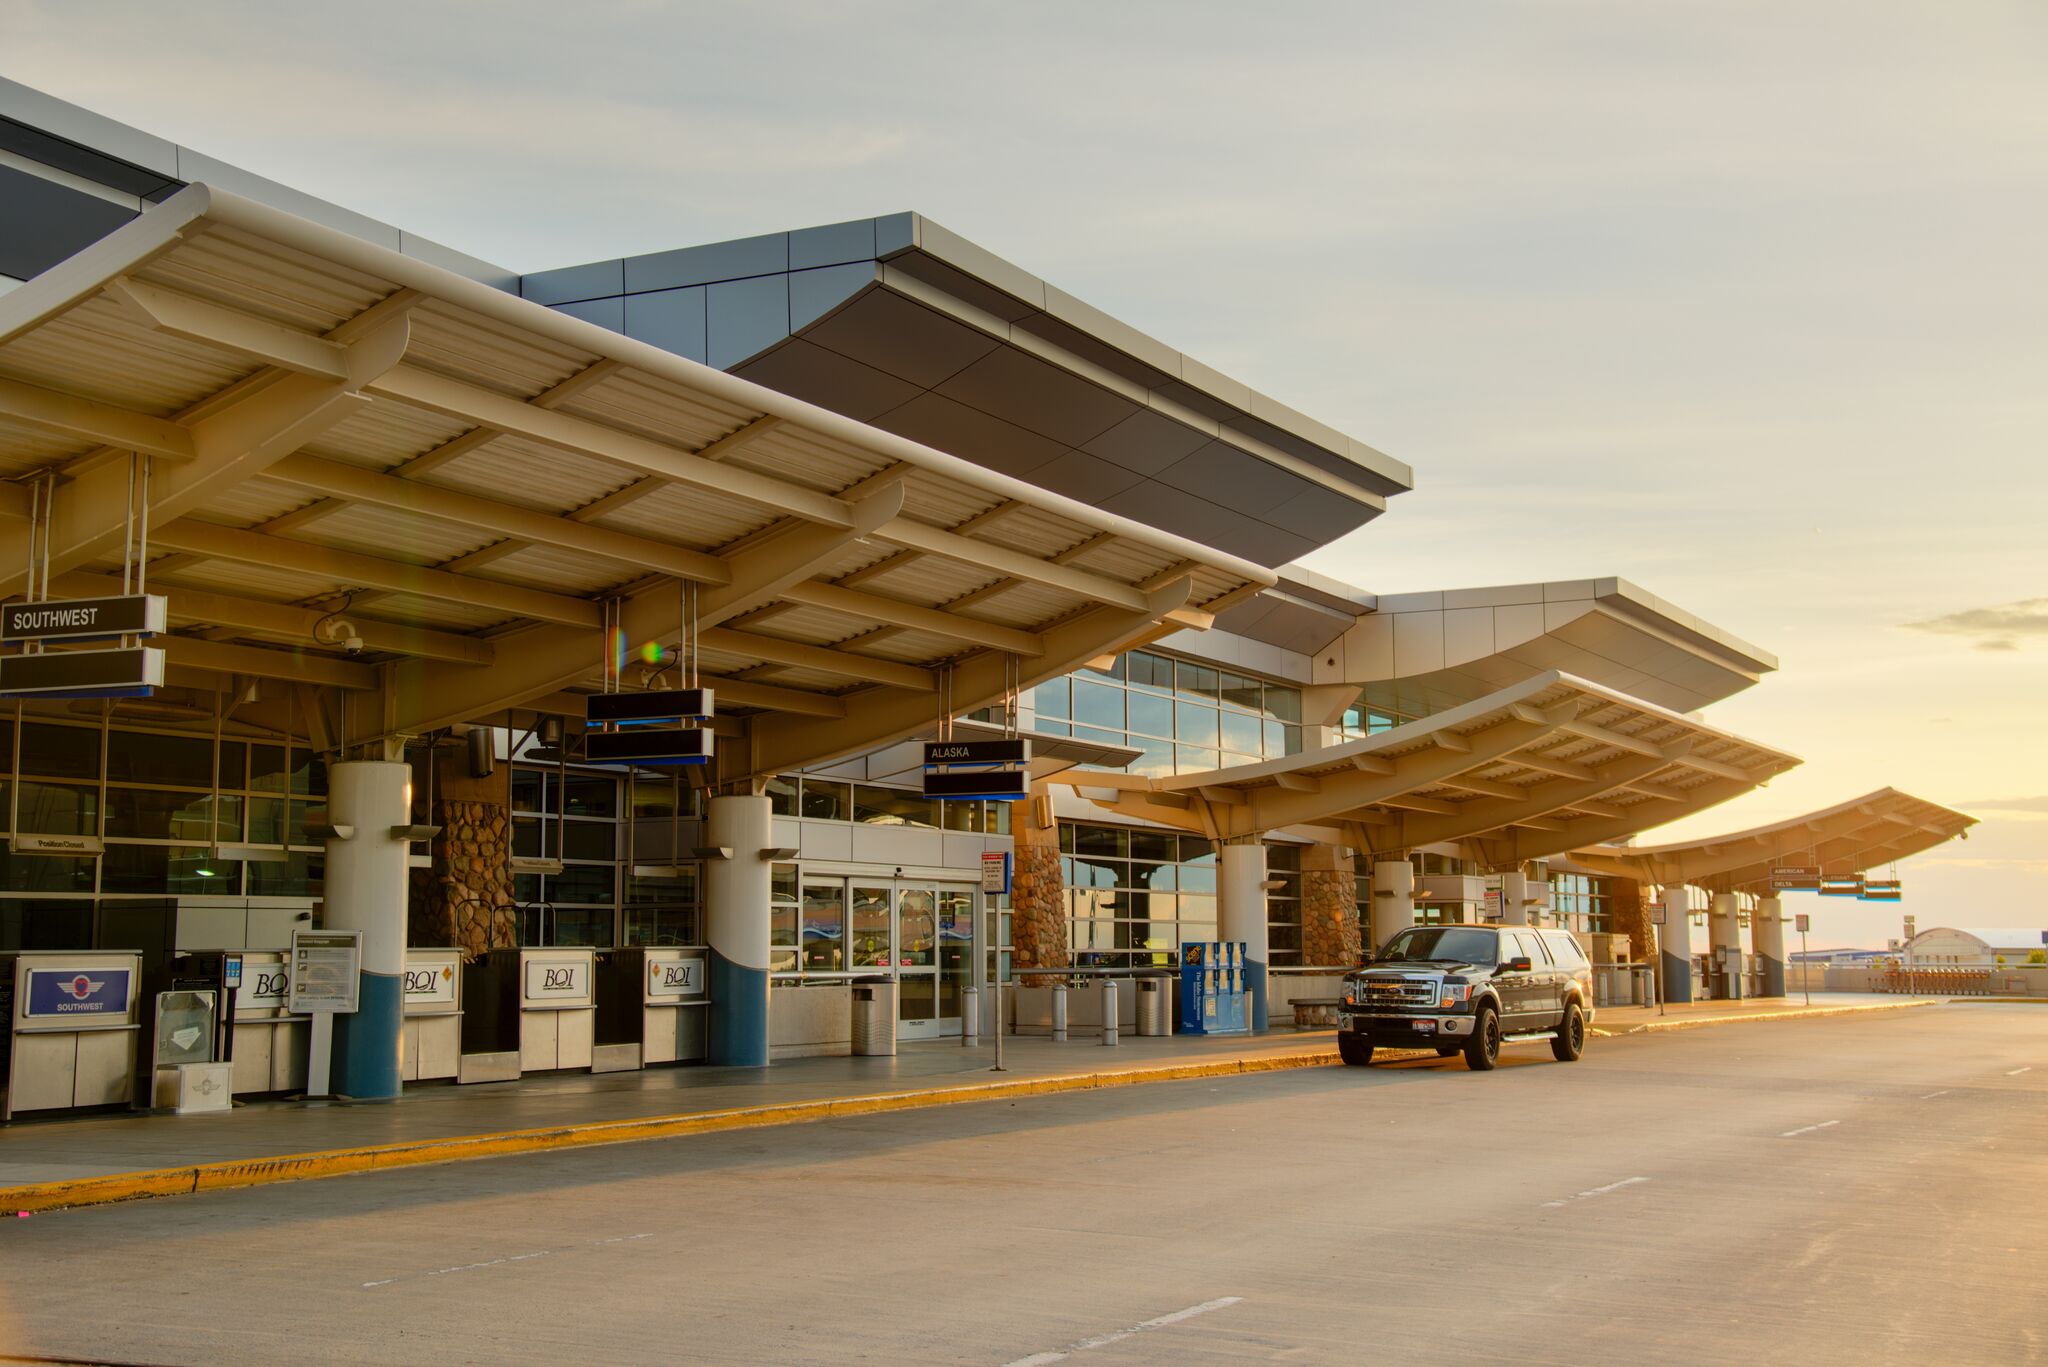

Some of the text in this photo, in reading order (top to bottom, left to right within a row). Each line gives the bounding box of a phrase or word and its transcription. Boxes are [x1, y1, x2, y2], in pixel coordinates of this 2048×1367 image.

[13, 608, 98, 630] SOUTHWEST
[931, 747, 970, 759] ALASKA
[38, 839, 63, 848] Position
[254, 973, 288, 995] BO
[405, 971, 438, 990] BOI
[543, 968, 574, 987] BOI
[665, 966, 690, 984] BOI
[57, 1002, 103, 1011] SOUTHWEST
